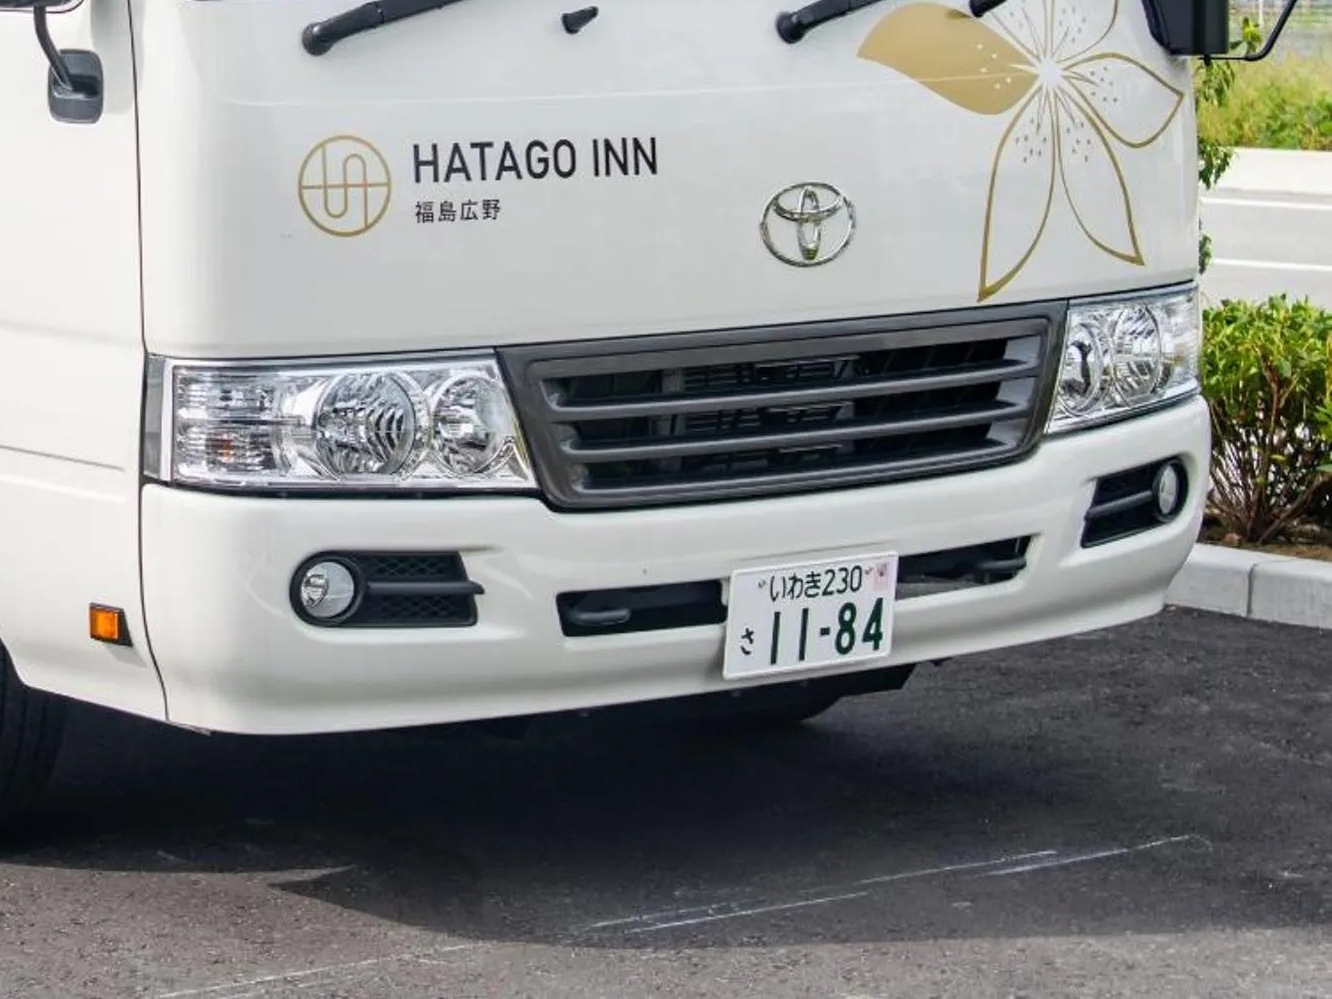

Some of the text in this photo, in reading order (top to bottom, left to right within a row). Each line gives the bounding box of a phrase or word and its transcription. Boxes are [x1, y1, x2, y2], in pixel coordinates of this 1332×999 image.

[412, 136, 659, 184] HATAGO INN
[414, 198, 502, 224] 福島広野
[740, 597, 884, 666] さ 11-84
